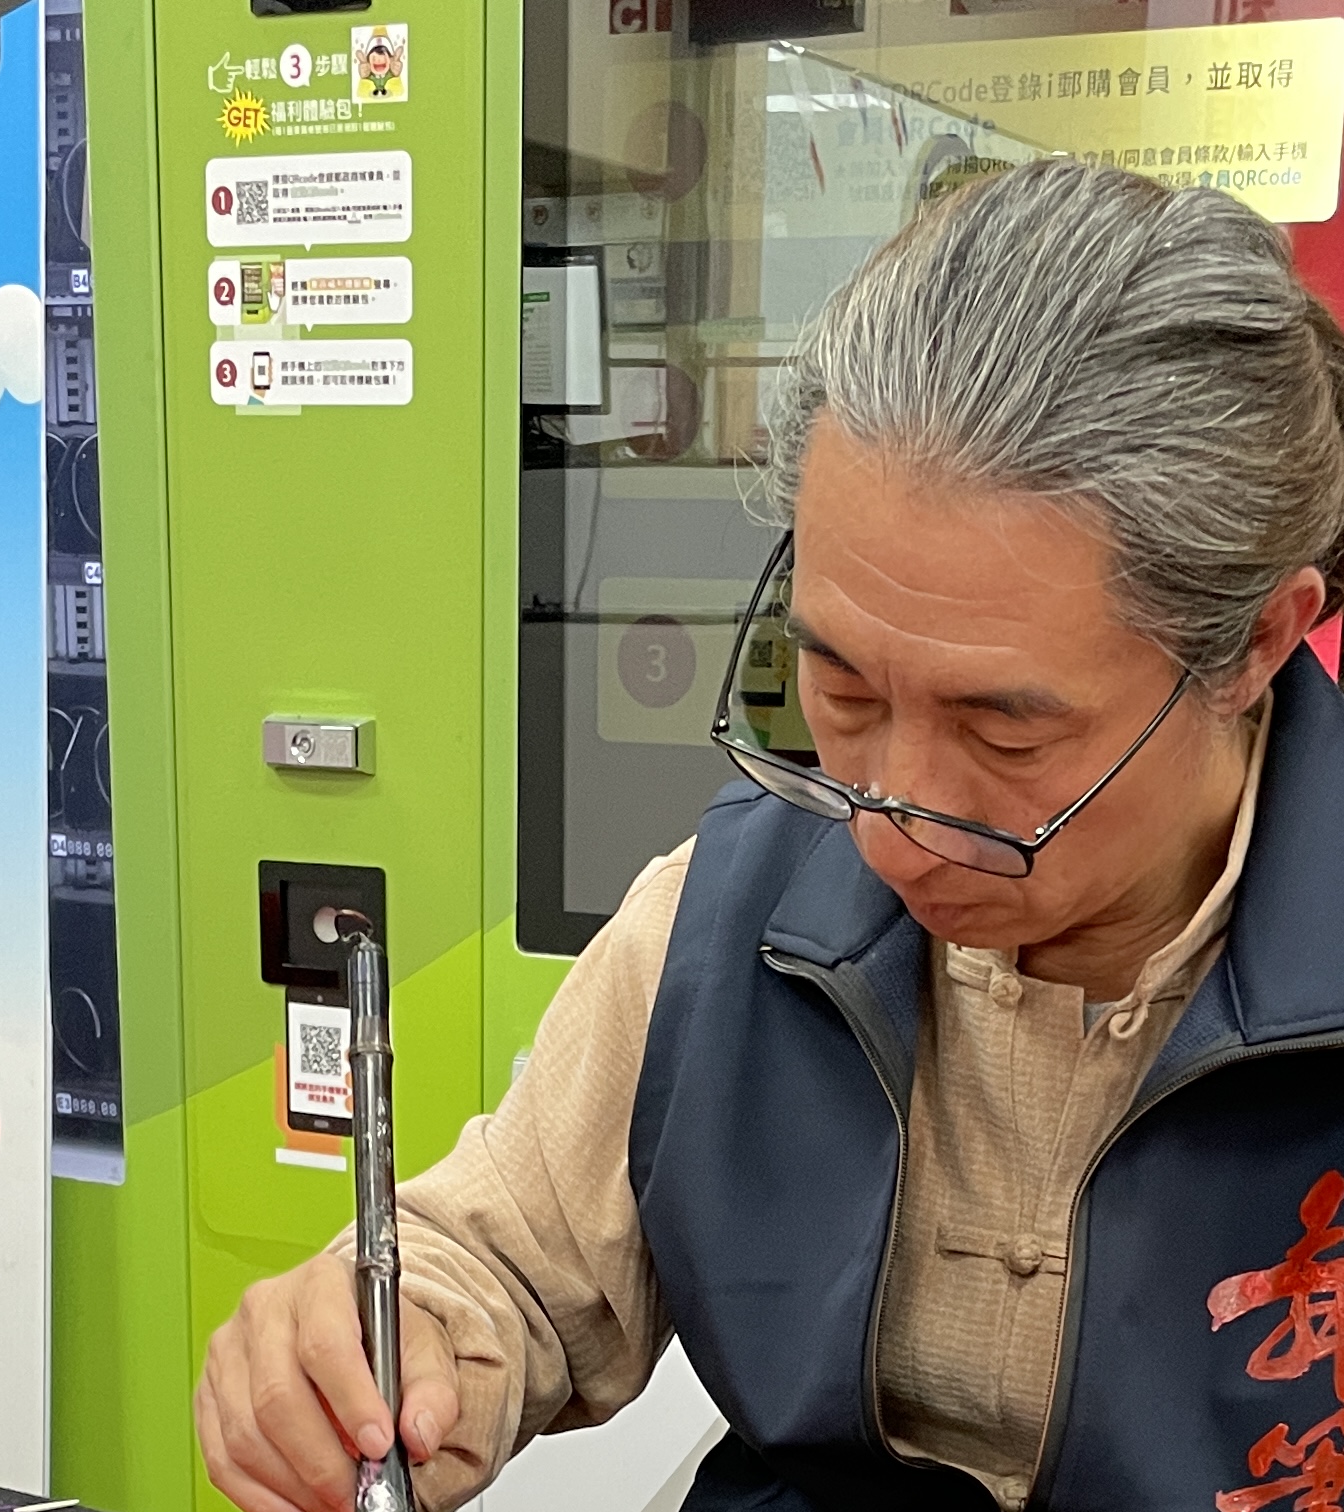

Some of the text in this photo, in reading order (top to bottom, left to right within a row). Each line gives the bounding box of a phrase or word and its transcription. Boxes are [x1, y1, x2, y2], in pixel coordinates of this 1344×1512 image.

[227, 106, 261, 128] GET
[218, 189, 227, 211] 1
[219, 282, 231, 302] 2
[221, 363, 233, 383] 3
[644, 643, 668, 682] 3
